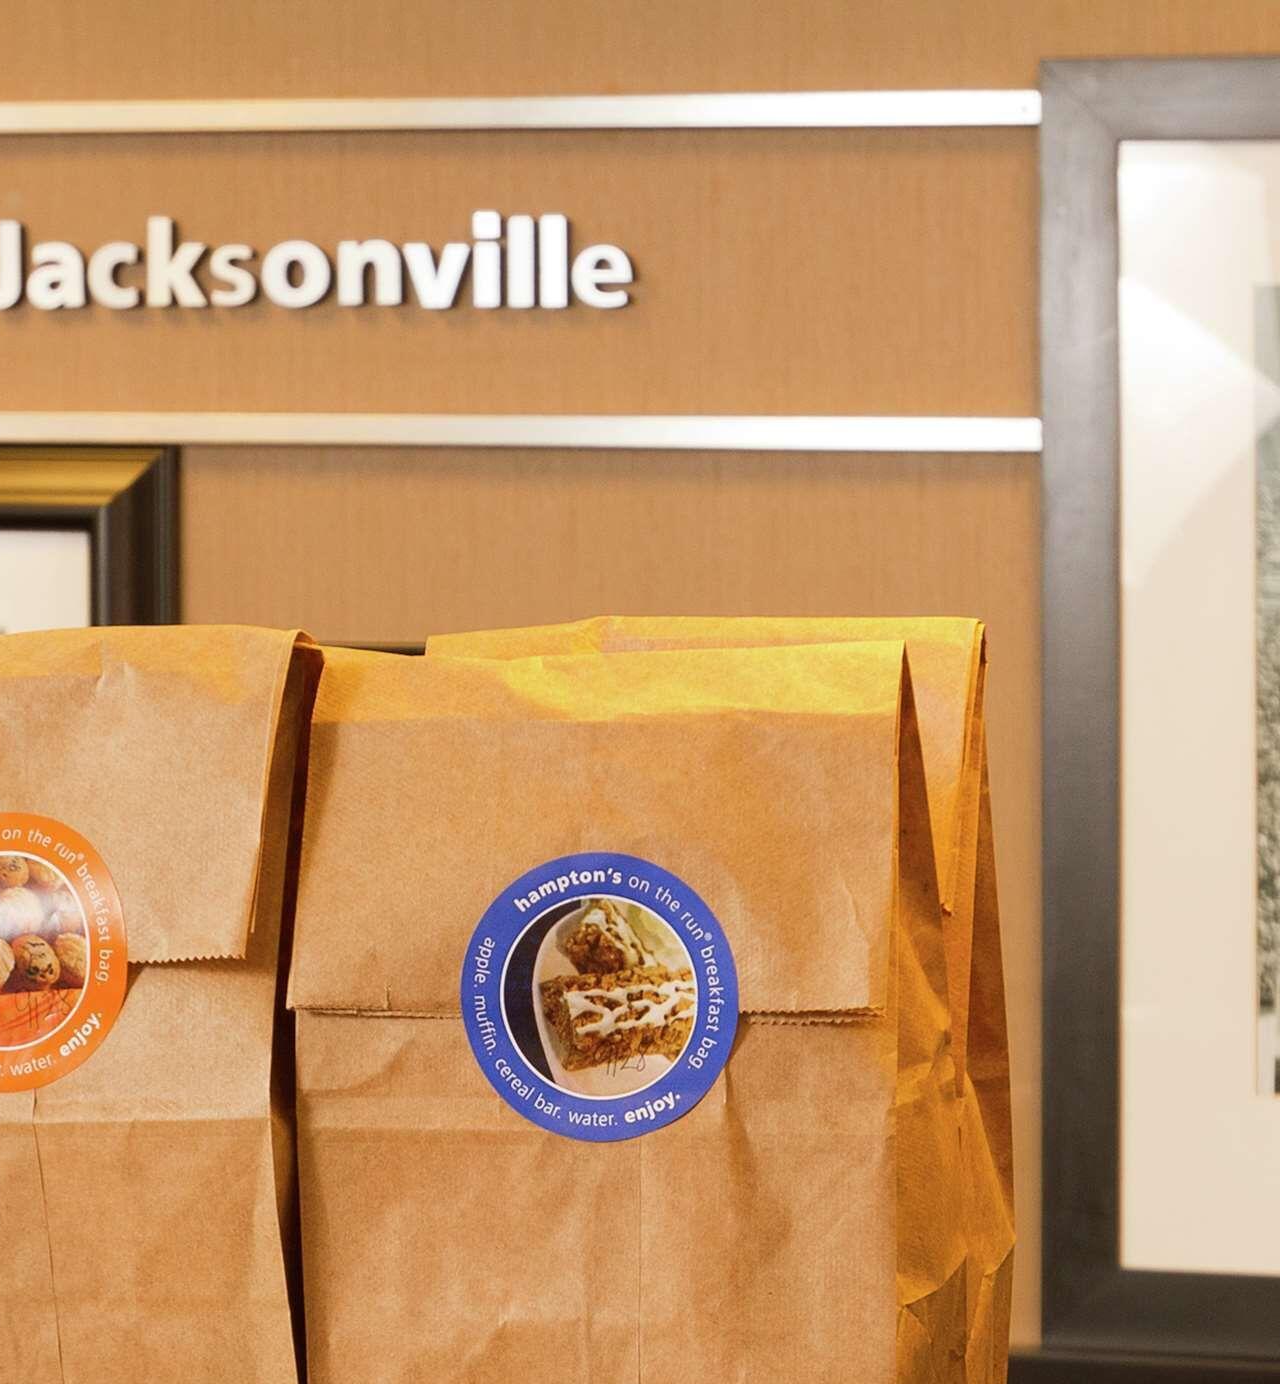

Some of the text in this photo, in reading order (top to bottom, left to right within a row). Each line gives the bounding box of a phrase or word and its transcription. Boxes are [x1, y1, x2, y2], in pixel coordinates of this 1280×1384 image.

[1, 828, 22, 841] on
[27, 829, 53, 849] the
[76, 862, 111, 943] breakfast
[514, 867, 623, 913] hampton's
[628, 873, 651, 894] on
[655, 885, 682, 913] the
[700, 944, 725, 1033] breakfast
[59, 1011, 103, 1058] enjoy.
[495, 1057, 534, 1100] cereal
[568, 1109, 619, 1127] water.
[623, 1091, 681, 1124] enjoy.
